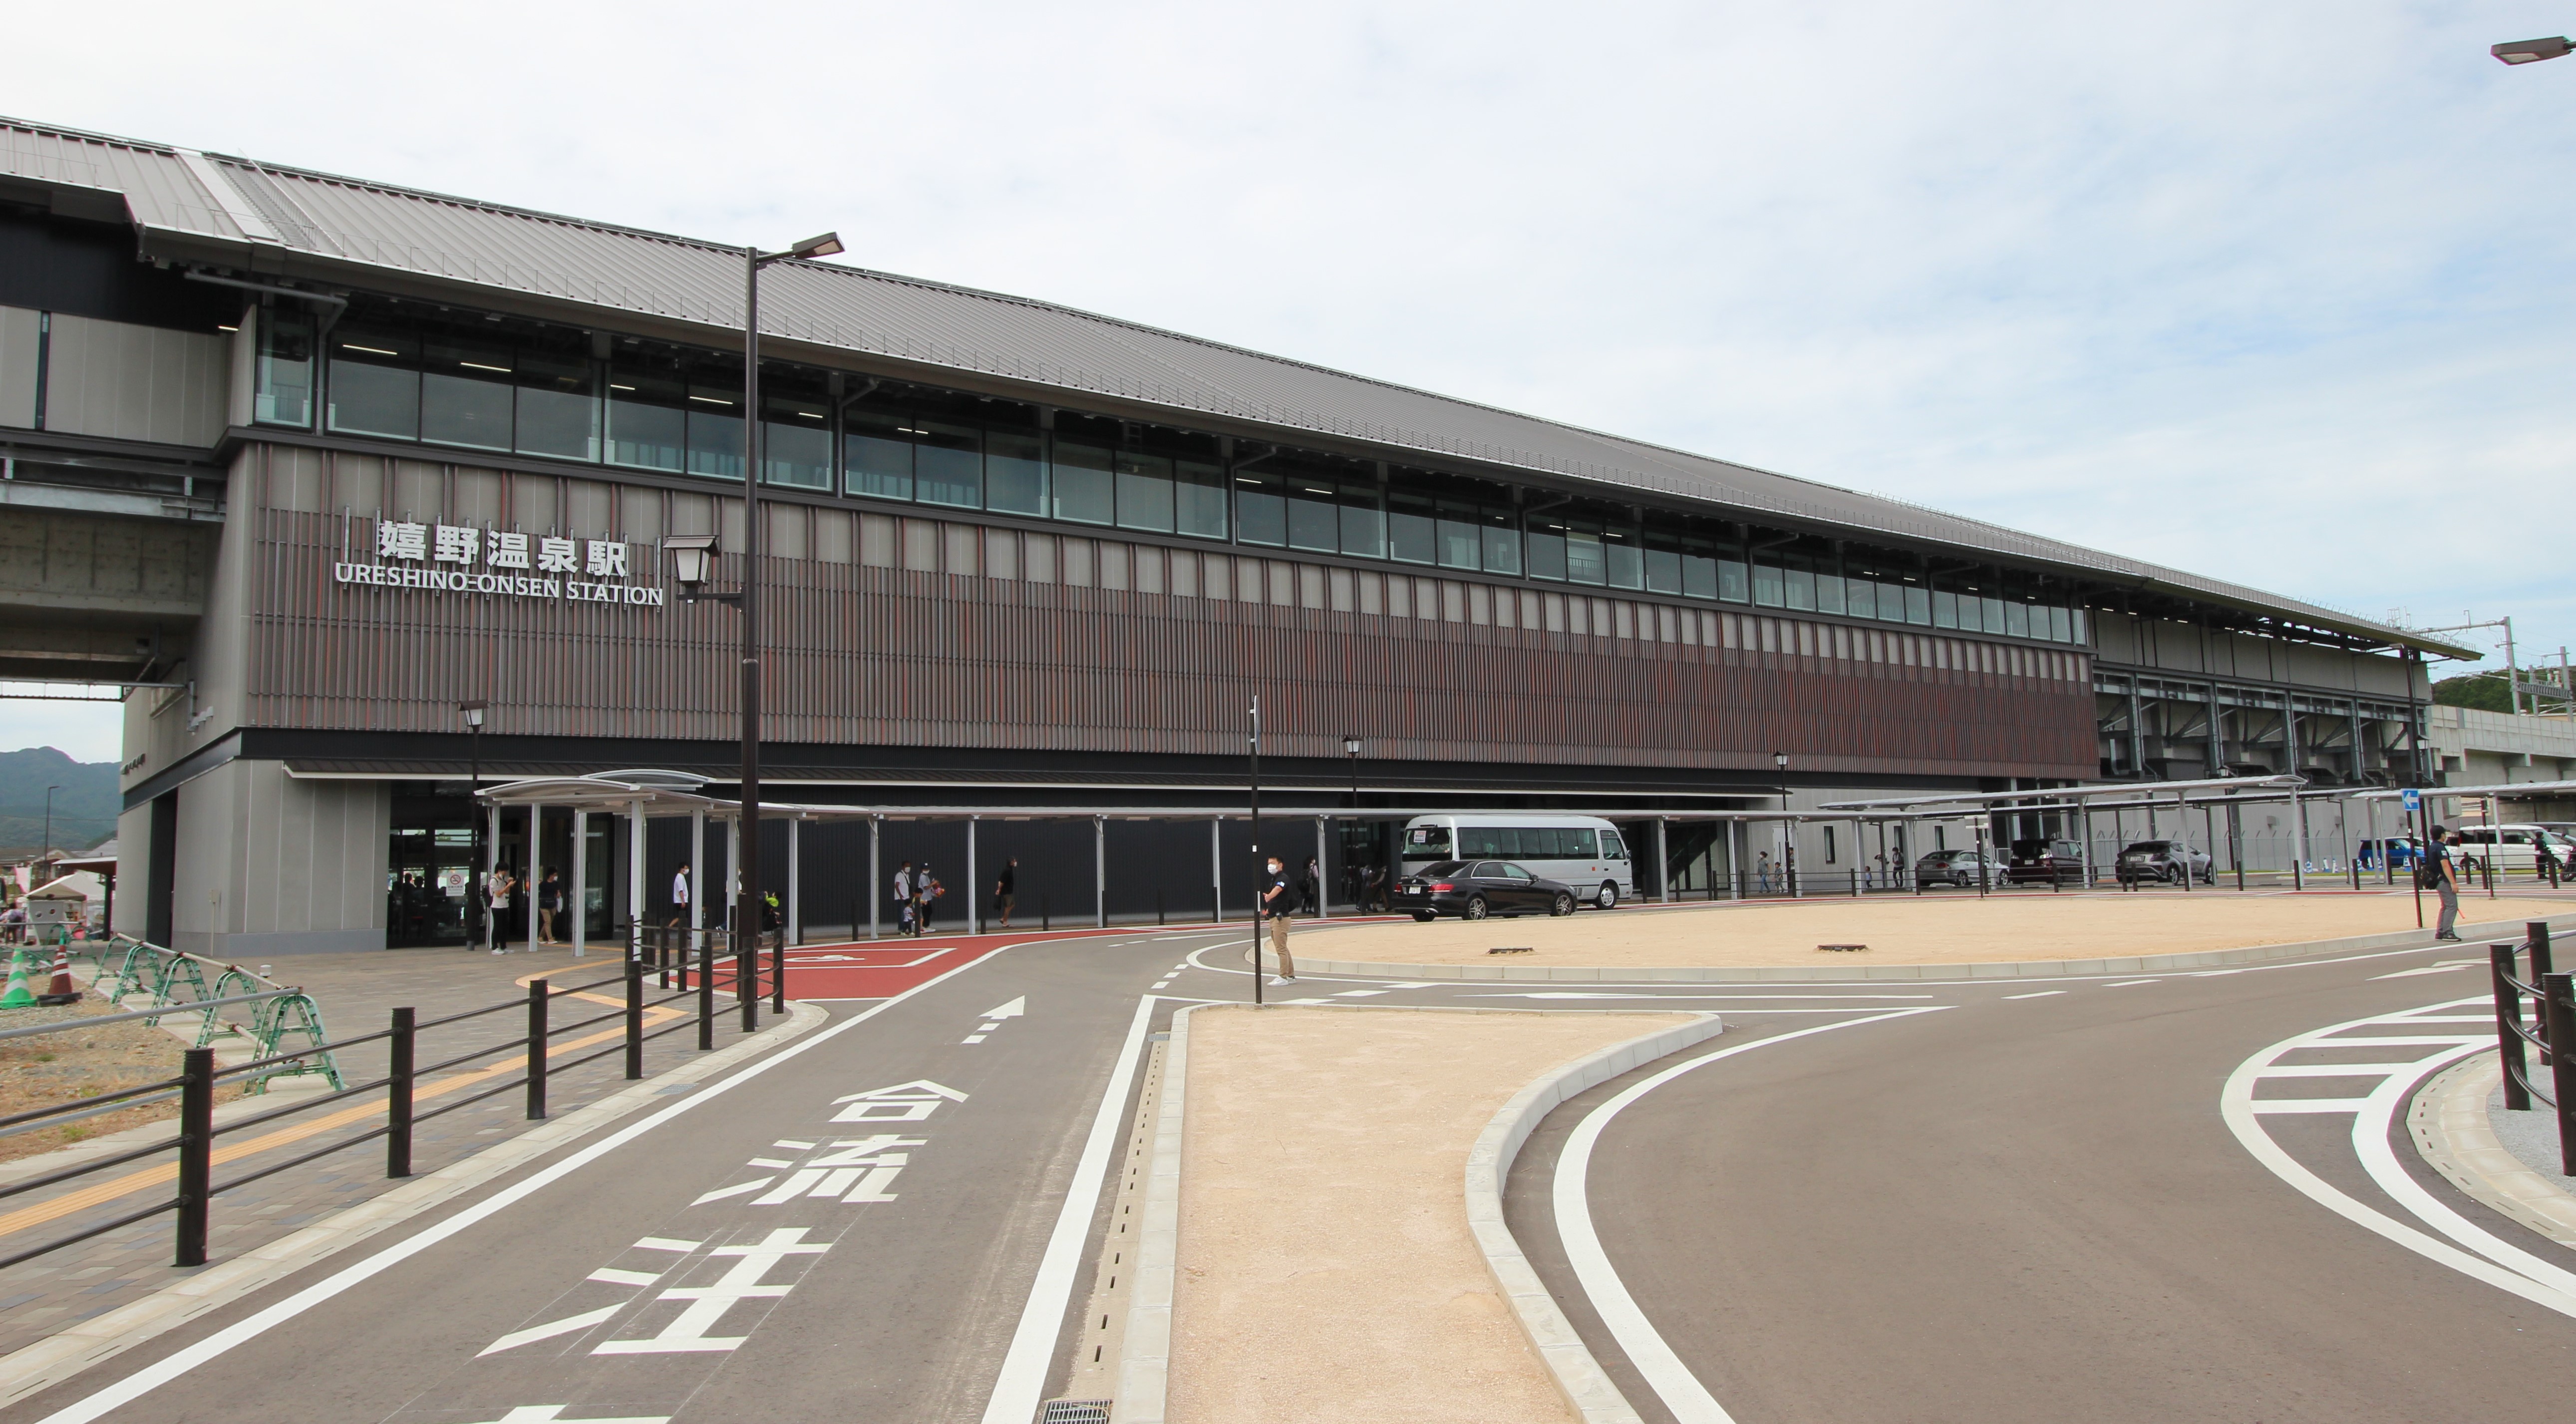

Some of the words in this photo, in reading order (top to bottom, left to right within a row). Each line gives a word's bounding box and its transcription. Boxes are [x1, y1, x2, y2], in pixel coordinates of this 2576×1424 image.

[380, 521, 626, 577] 嬉野温泉駅
[335, 562, 560, 598] URESHINO-ONSEN
[566, 580, 663, 606] STATION
[470, 1079, 969, 1424] 合流注
